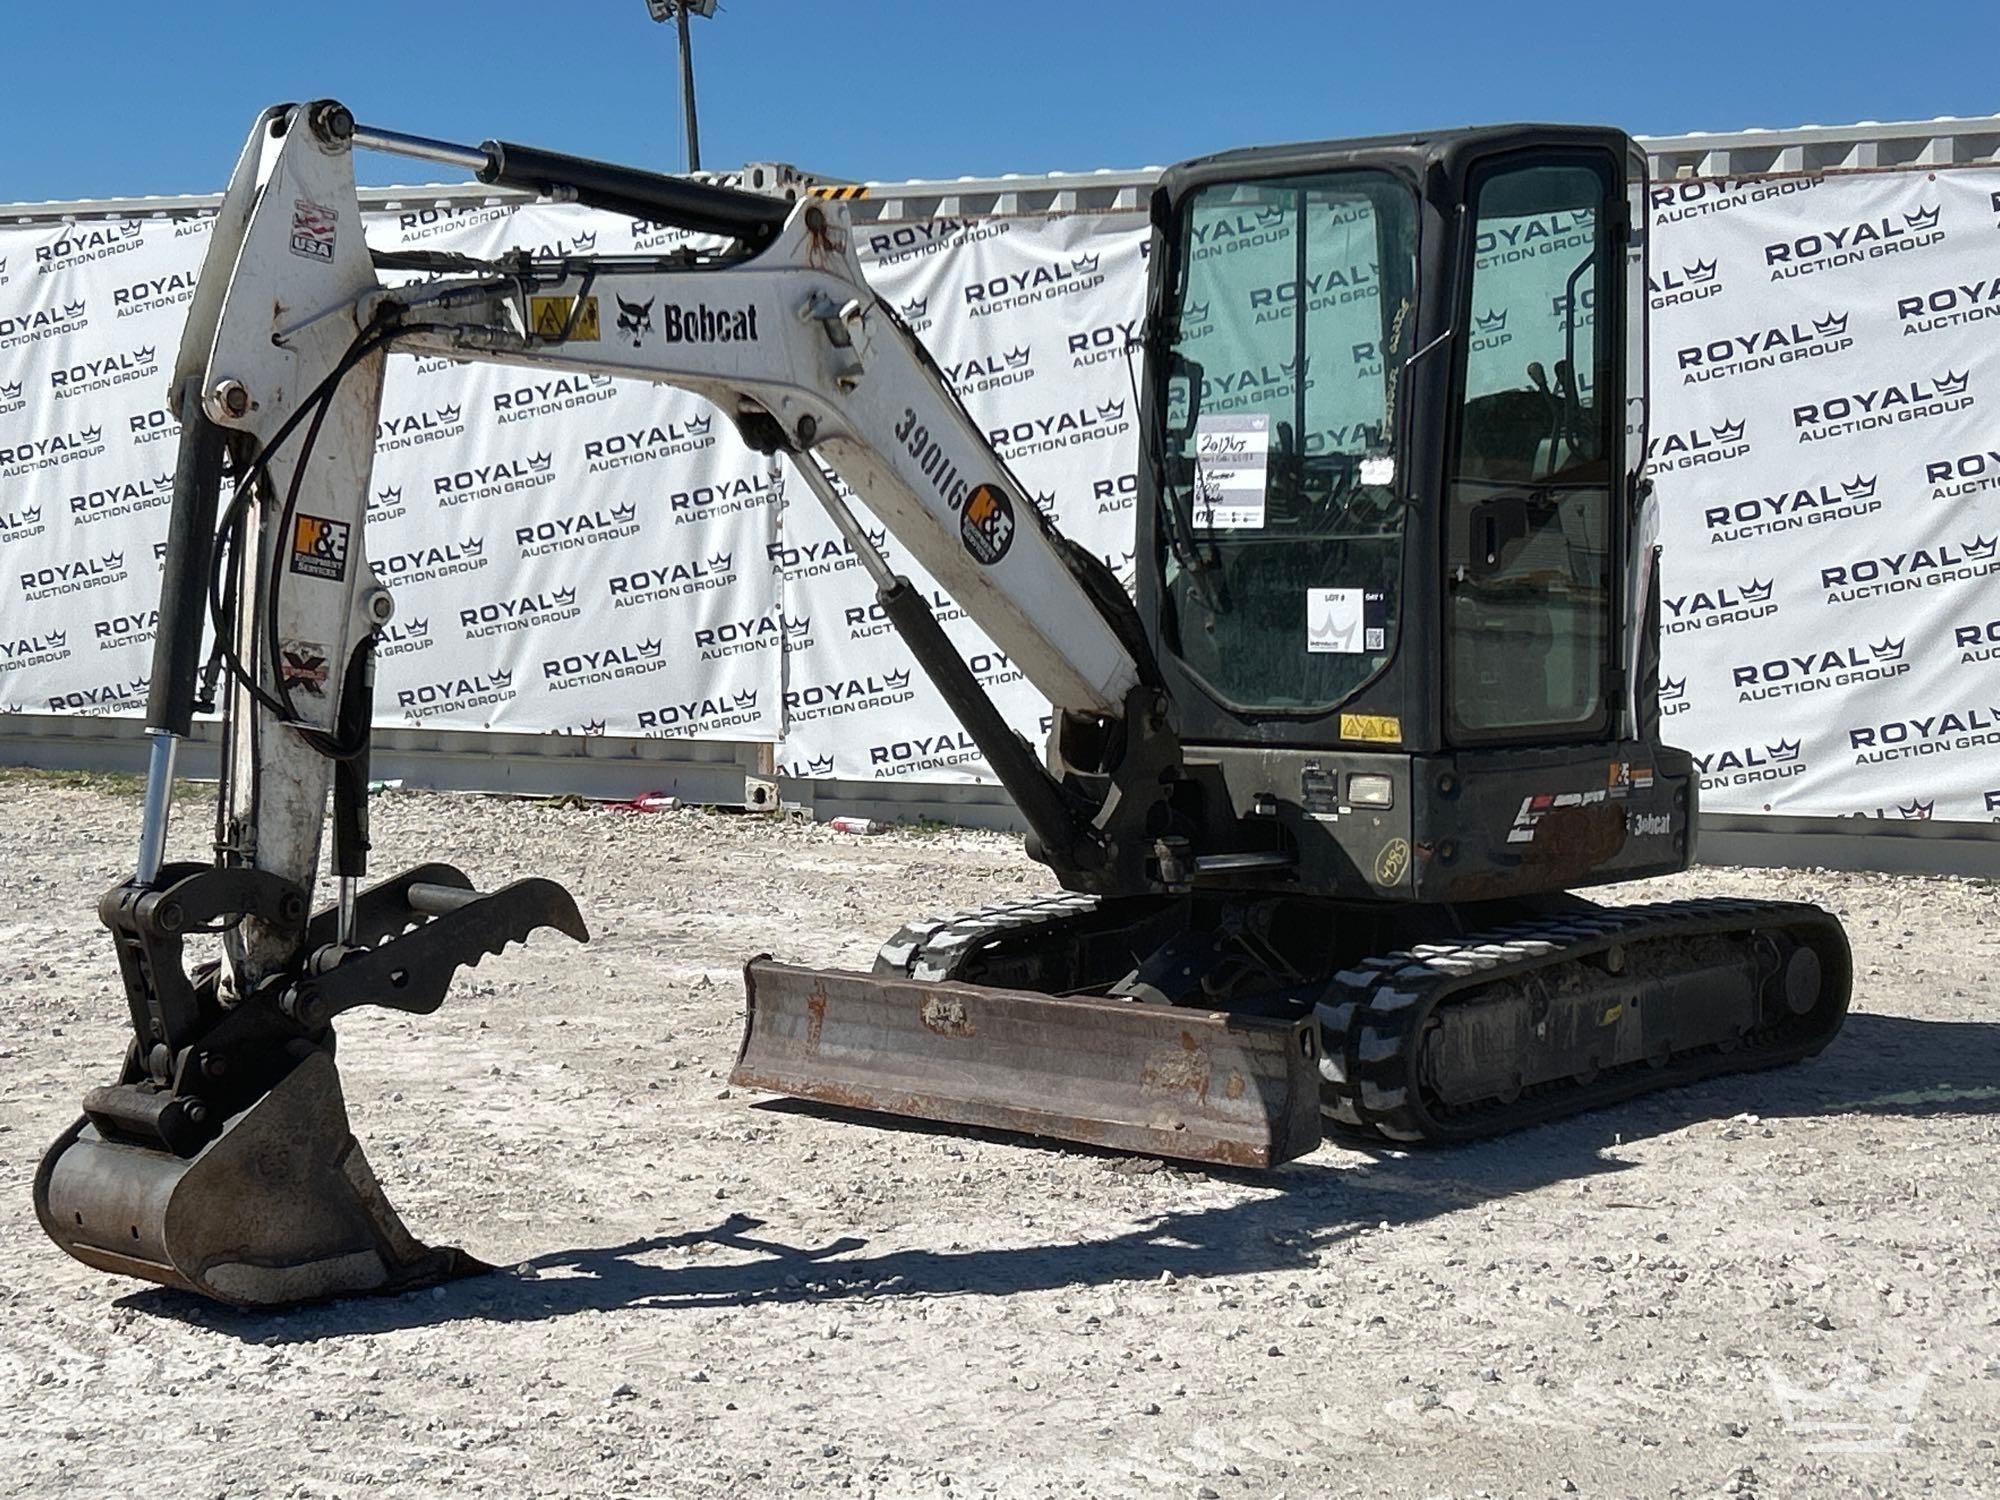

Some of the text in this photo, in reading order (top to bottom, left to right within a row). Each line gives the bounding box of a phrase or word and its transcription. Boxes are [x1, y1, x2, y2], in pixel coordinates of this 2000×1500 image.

[1656, 178, 1825, 226] AUCTION GROUP
[35, 228, 119, 262] ROYAL
[401, 219, 466, 243] AUCTION
[878, 223, 1010, 268] AUCTION GROUP
[1192, 216, 1256, 244] YAL
[1226, 227, 1290, 254] GROUP
[1475, 216, 1572, 254] OYAL
[1765, 218, 1904, 266] ROYAL
[38, 239, 144, 275] AUCTION GROUP
[293, 236, 331, 257] USA
[1476, 232, 1595, 270] CTION GROU
[1770, 231, 1946, 282] AUCTION GROUP
[965, 263, 1072, 304] ROYAL
[969, 274, 1105, 319] AUCTION GROUP
[1340, 285, 1379, 302] GRO
[1650, 284, 1722, 311] GROUP
[0, 308, 64, 336] OYAL
[117, 296, 175, 319] AUCTION
[664, 303, 758, 344] Bobcat
[1, 320, 88, 350] CTION GROUP
[1471, 333, 1512, 352] OUP
[1678, 323, 1814, 370] ROYAL
[51, 354, 134, 388] ROYAL
[943, 355, 1005, 383] YAL
[1683, 338, 1854, 386] AUCTION GROUP
[54, 364, 158, 400] AUCTION GROUP
[494, 375, 589, 411] ROYAL
[977, 369, 1035, 392] GROUP
[498, 388, 618, 424] AUCTION GROUP
[1793, 381, 1933, 428] ROYAL
[1799, 396, 1974, 444] AUCTION GROUP
[134, 427, 182, 445] AUCTIO
[375, 425, 464, 454] TION GROUP
[584, 424, 684, 460] ROYAL
[989, 409, 1097, 448] ROYAL
[1070, 422, 1130, 444] GROUP
[2, 446, 105, 478] AUCTION GROUP
[589, 436, 716, 474] AUCTION GROUP
[895, 408, 968, 511] 390116
[1678, 444, 1750, 468] GROUP
[434, 459, 528, 494] ROYAL
[438, 473, 556, 508] AUCTION GROUP
[70, 481, 153, 512] ROYAL
[670, 475, 768, 512] ROYAL
[1705, 485, 1842, 530] ROYAL
[74, 495, 173, 525] AUCTION GROU
[367, 508, 406, 524] ROUP
[675, 500, 742, 525] AUCTION
[1711, 500, 1882, 545] AUCTION GROUP
[2, 525, 45, 542] GROUP
[516, 511, 611, 546] ROYAL
[521, 524, 641, 559] AUCTION GROUP
[20, 558, 103, 590] ROYAL
[383, 558, 488, 588] UCTION GROUP
[609, 561, 708, 596] ROYAL
[1821, 546, 1961, 589] ROYAL
[25, 571, 128, 602] AUCTION GROUP
[614, 574, 737, 609] AUCTION GROUP
[1827, 578, 1922, 605] AUCTION
[459, 594, 552, 628] ROYAL
[1663, 589, 1739, 617] YAL
[1705, 604, 1779, 626] GROUP
[94, 610, 159, 638] ROYA
[466, 607, 581, 639] AUCTION GROUP
[0, 637, 47, 658] YAL
[27, 650, 71, 667] GROUP
[385, 640, 433, 657] GROUP
[542, 646, 638, 679] ROYAL
[700, 639, 767, 661] AUCTION
[549, 659, 666, 691] AUCTION GROUP
[1733, 647, 1870, 688] ROYAL
[1738, 663, 1911, 703] AUCTION GROUP
[49, 683, 131, 713] ROYAL
[113, 699, 149, 711] GROU
[398, 676, 489, 708] ROYAL
[404, 689, 516, 720] AUCTION GROUP
[783, 677, 884, 710] ROYAL
[787, 691, 914, 723] AUCTION GROUP
[638, 697, 734, 728] ROYAL
[712, 711, 762, 729] GROUP
[1849, 710, 1991, 750] ROYAL
[874, 751, 982, 778] AUCTION GRO
[1692, 747, 1767, 774] YAL
[1855, 732, 2000, 765] AUCTION GRO
[1733, 764, 1806, 785] GROUP
